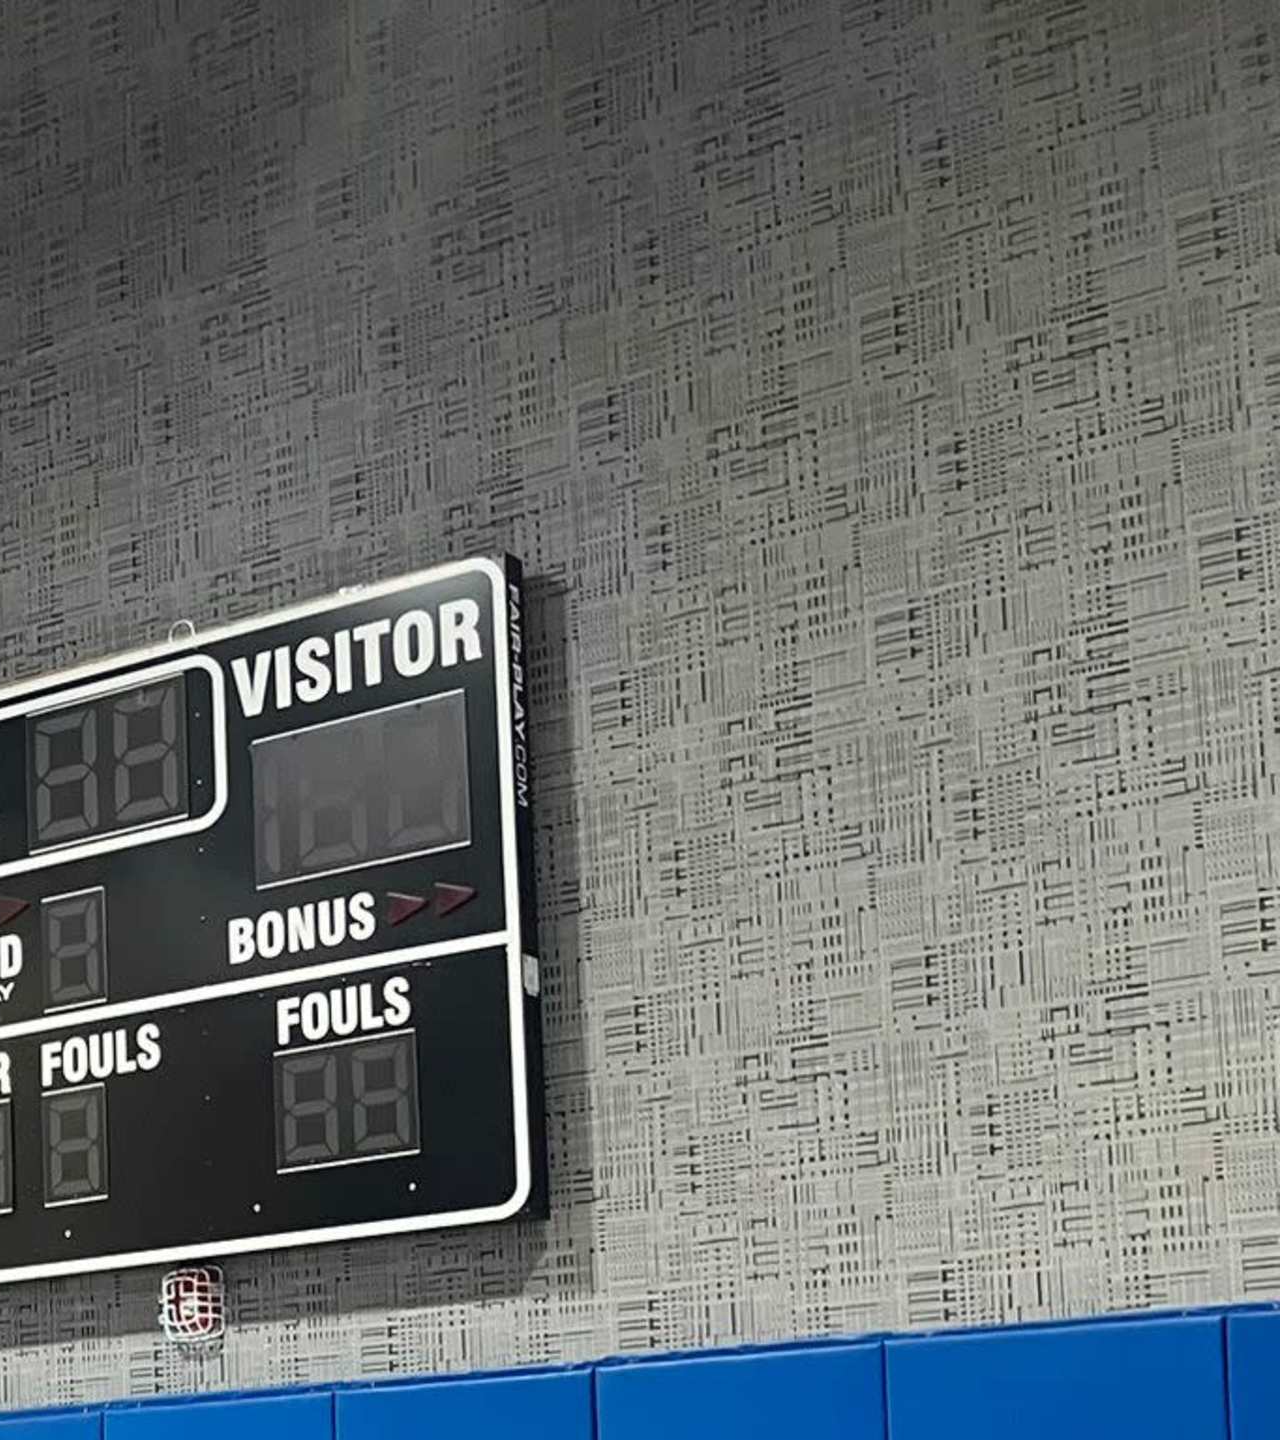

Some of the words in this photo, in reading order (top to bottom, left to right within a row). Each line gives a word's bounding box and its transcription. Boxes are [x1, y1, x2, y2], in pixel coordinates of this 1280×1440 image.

[231, 599, 482, 717] VISITOR
[228, 891, 376, 965] BONUS
[277, 976, 411, 1045] FOULS
[41, 1023, 161, 1088] FOULS
